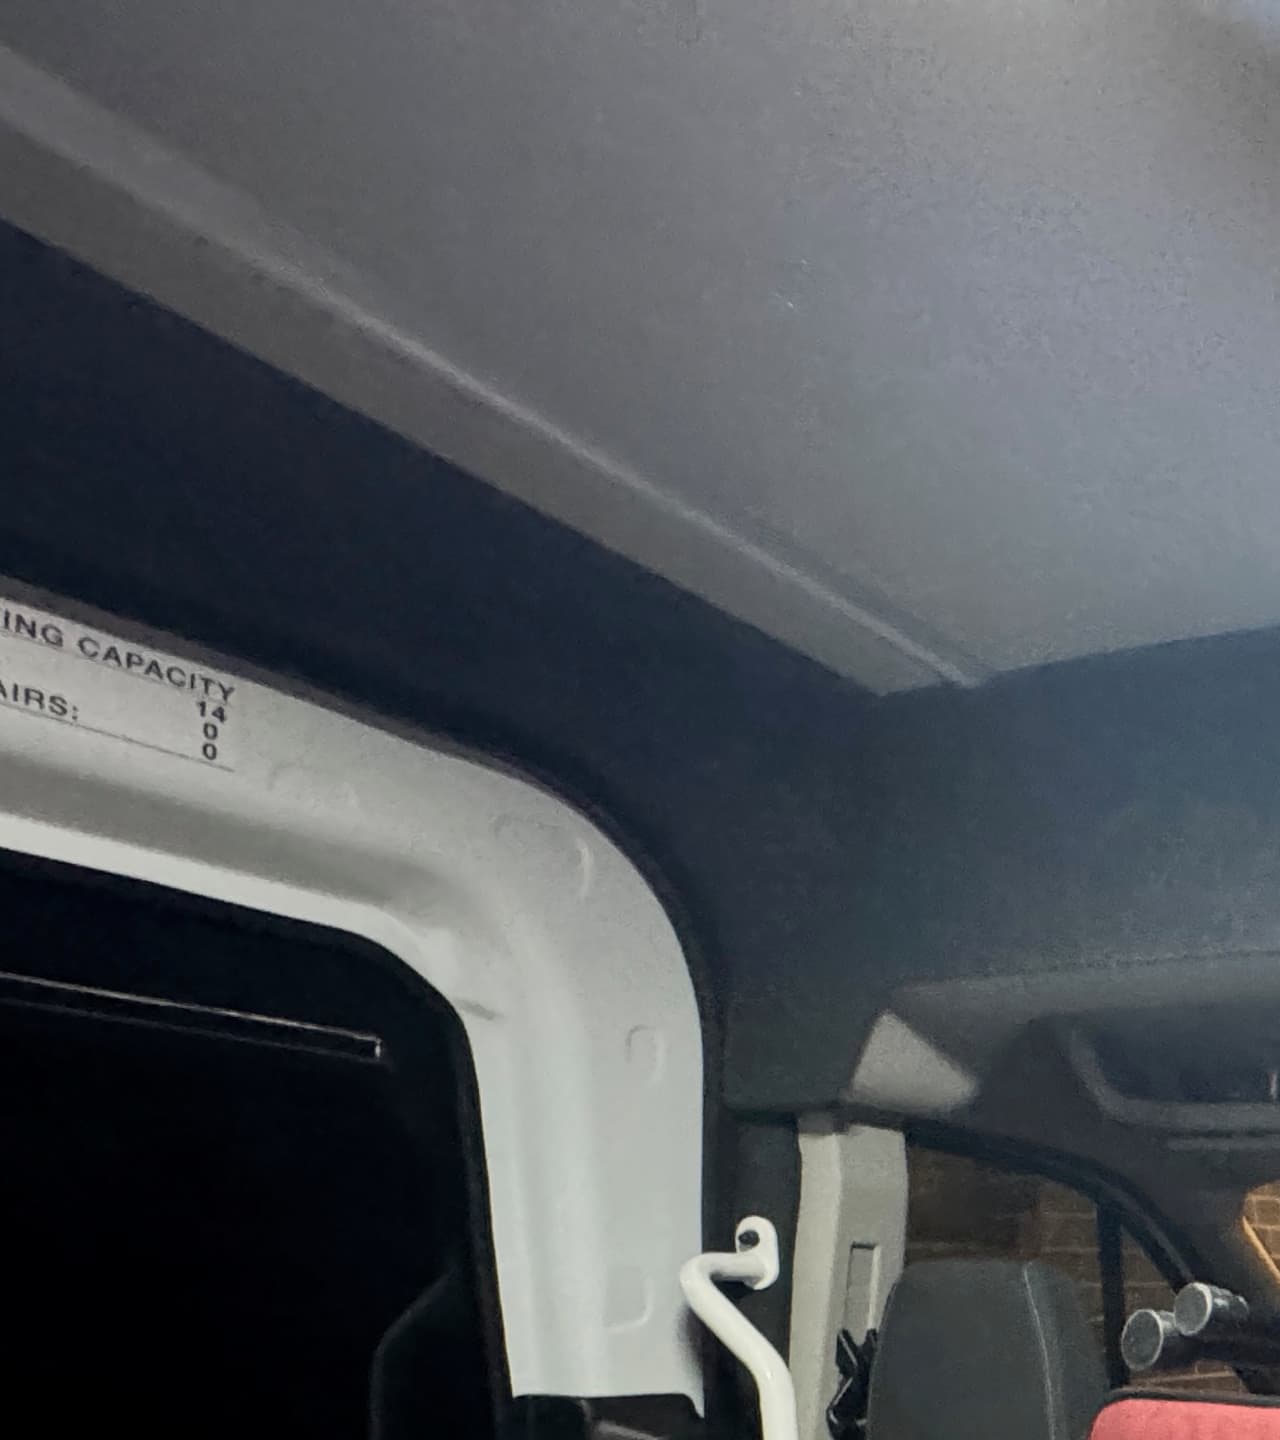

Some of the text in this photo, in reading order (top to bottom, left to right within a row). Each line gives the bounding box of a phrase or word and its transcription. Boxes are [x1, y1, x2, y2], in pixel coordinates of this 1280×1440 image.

[78, 636, 235, 704] CAPACITY
[197, 700, 227, 724] 14
[203, 723, 218, 741] 0
[202, 743, 217, 761] 0
